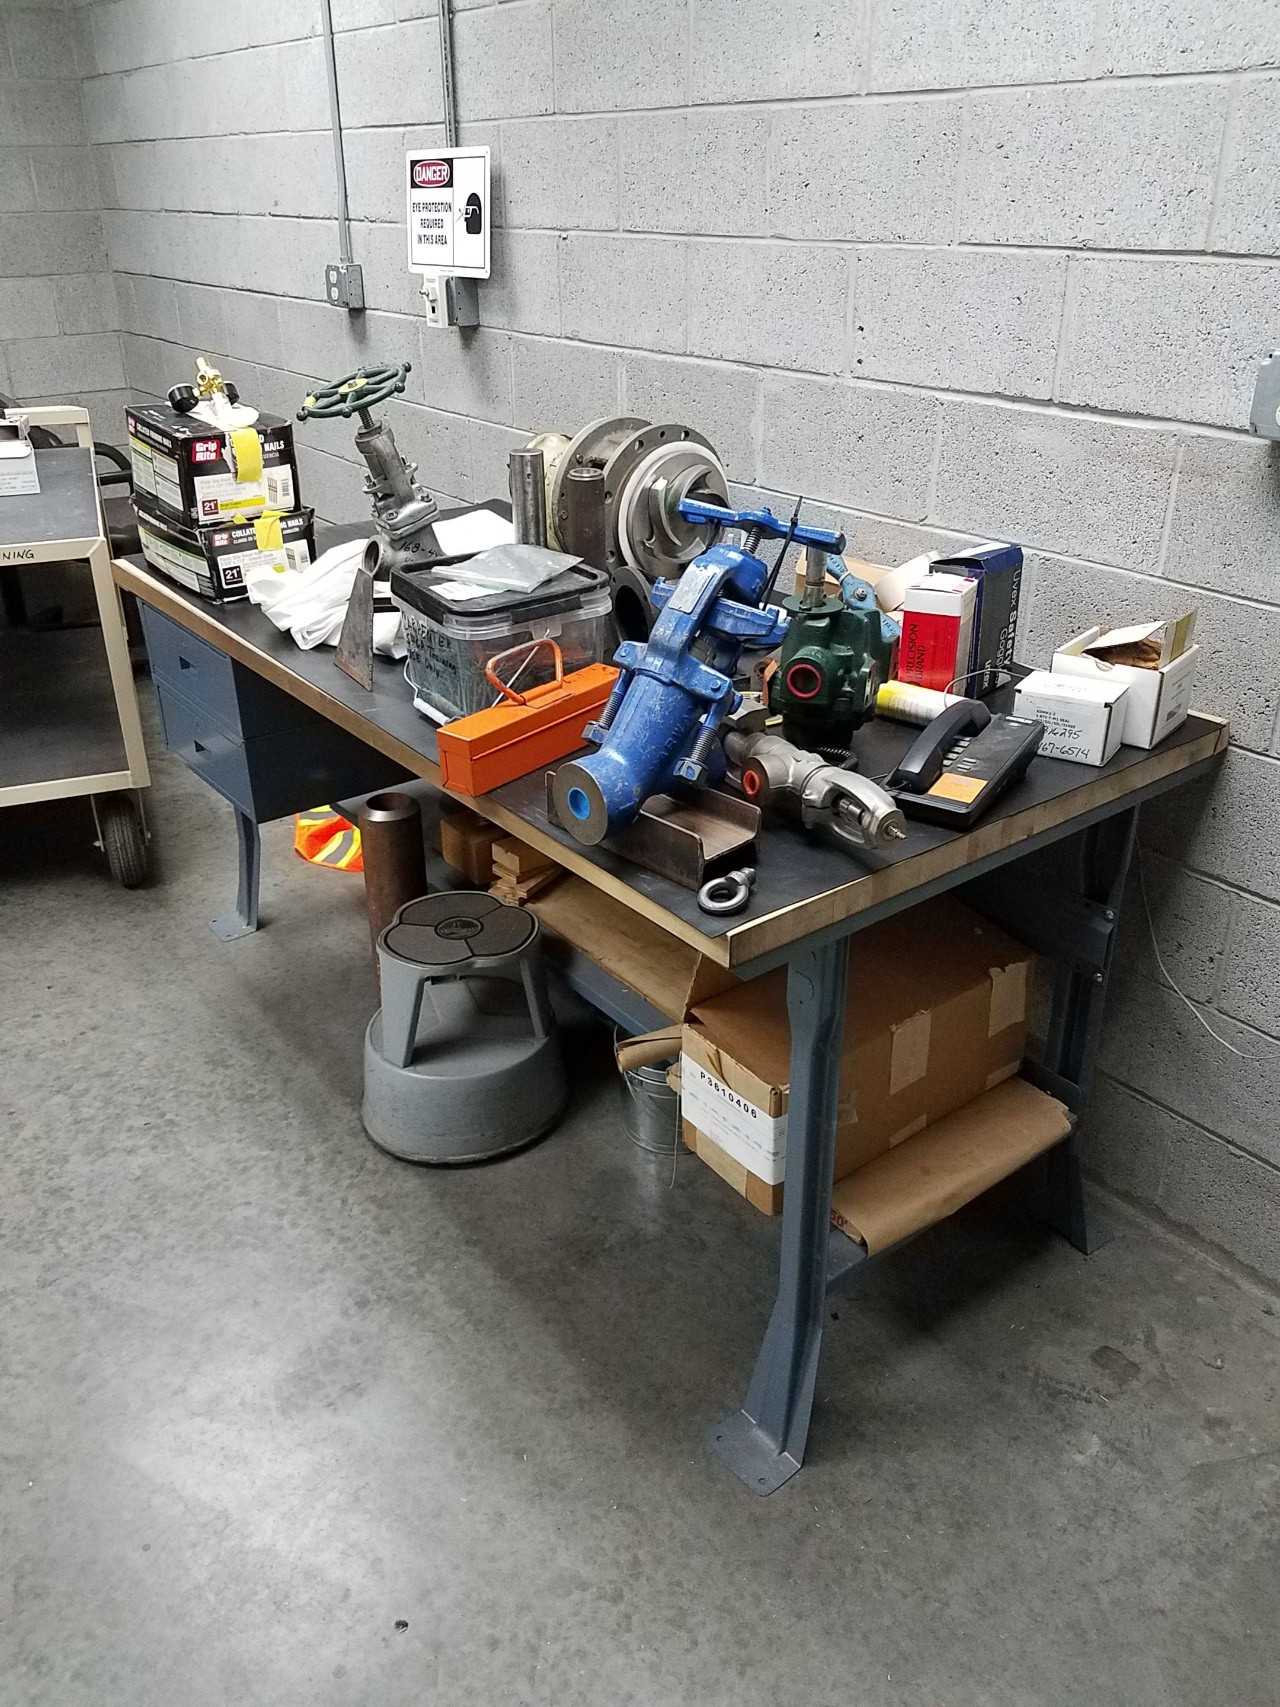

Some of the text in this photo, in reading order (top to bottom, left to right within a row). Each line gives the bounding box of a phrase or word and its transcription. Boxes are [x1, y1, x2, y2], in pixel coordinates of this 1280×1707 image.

[416, 165, 449, 181] DANGER
[412, 202, 452, 212] EYE PROTECTION
[420, 218, 444, 228] REQUIRED
[417, 234, 448, 245] IN THIS AREA
[195, 441, 218, 453] Grip
[264, 441, 285, 452] NAILS
[195, 451, 217, 462] Rite
[231, 527, 257, 538] COLLATE
[1003, 568, 1022, 665] Uvex Safety
[700, 1071, 758, 1119] P3610406
